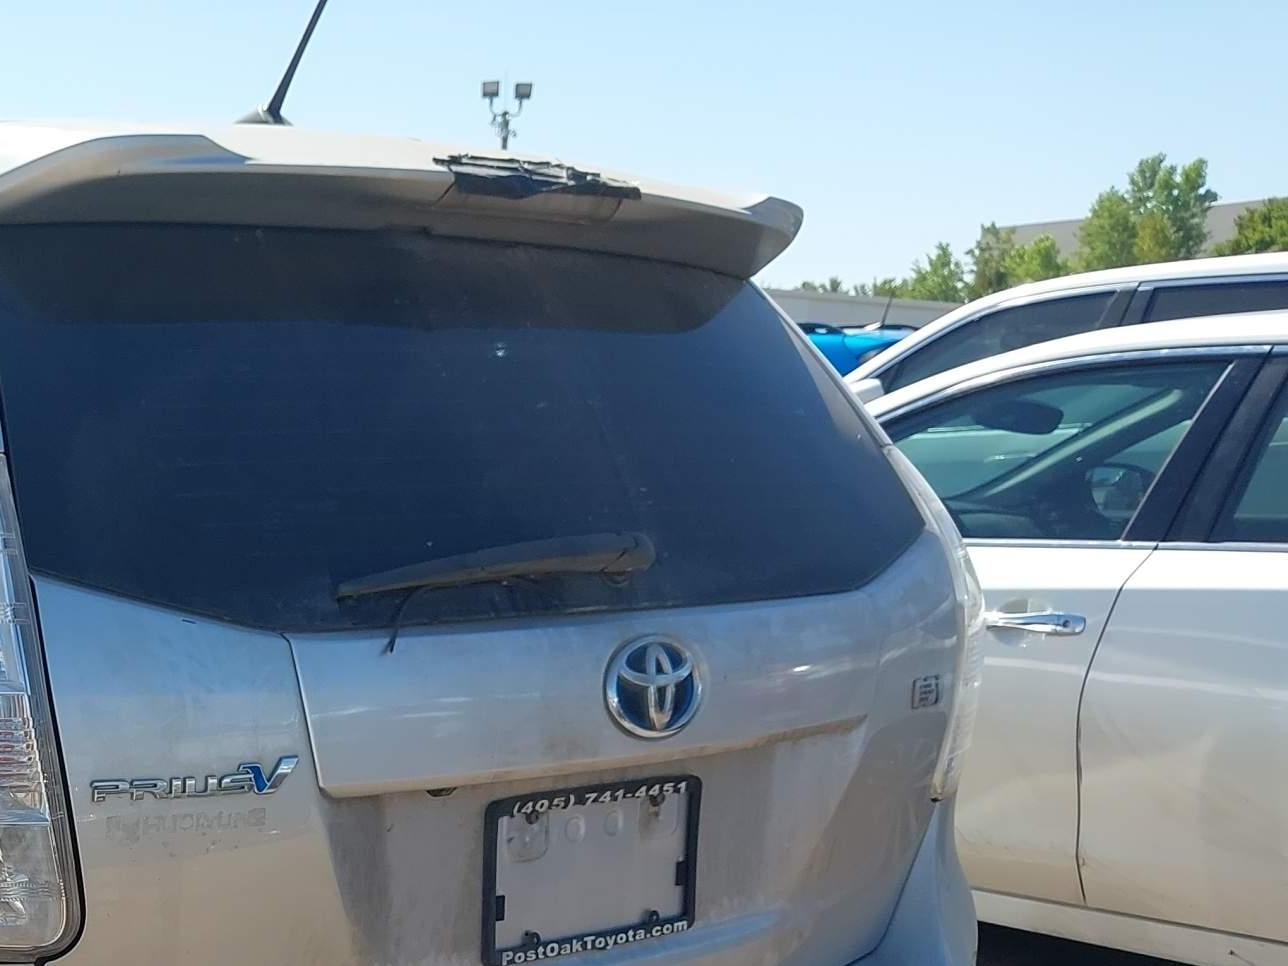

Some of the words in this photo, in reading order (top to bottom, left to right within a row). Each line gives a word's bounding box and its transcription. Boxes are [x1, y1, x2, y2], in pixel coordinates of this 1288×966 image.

[90, 774, 255, 802] PRIUS
[513, 794, 575, 816] (405)
[585, 781, 689, 806] 741-4451
[501, 919, 689, 966] PostOakToyota.com
